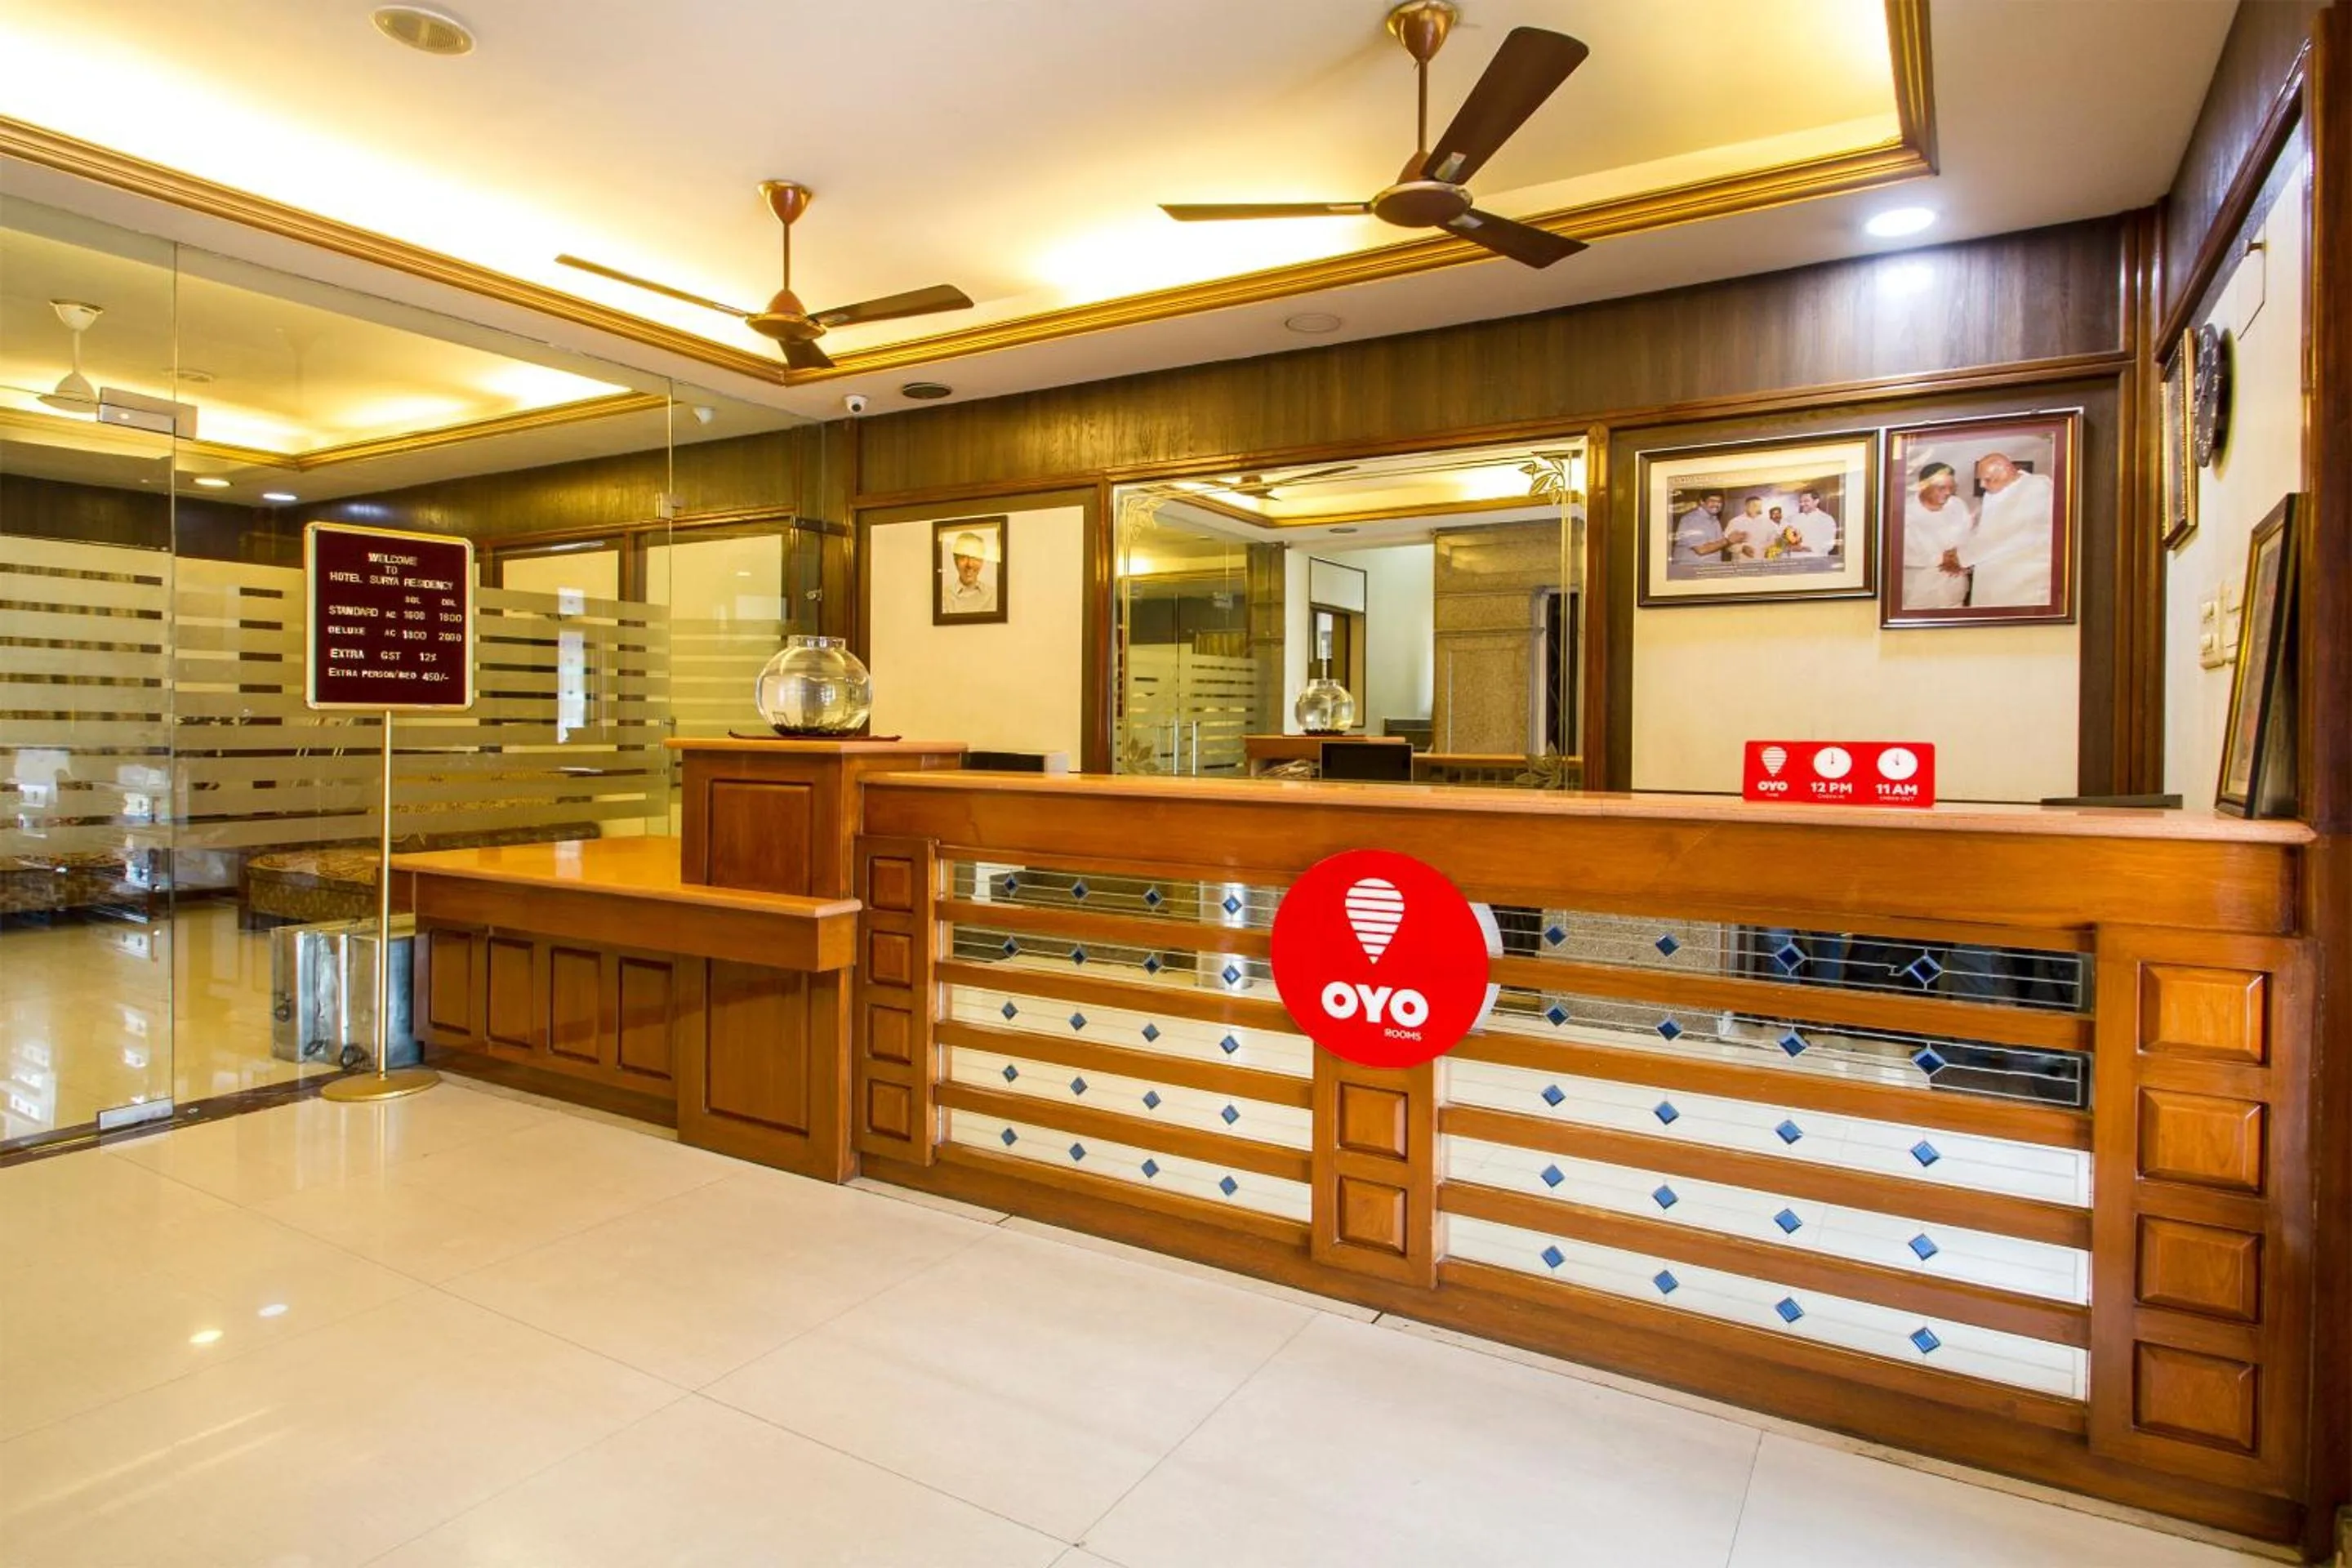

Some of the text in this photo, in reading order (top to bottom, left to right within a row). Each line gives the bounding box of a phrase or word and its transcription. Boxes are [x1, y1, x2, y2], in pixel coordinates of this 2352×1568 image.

[368, 552, 418, 567] WELCOME
[385, 565, 398, 574] TO
[330, 572, 453, 590] HOTEL SURYA RESIDENCY
[328, 605, 378, 617] STANDARD
[327, 625, 366, 635] DELUXE
[438, 632, 462, 642] 2000
[330, 648, 365, 659] EXTRA
[381, 650, 402, 661] GST
[1757, 781, 1788, 792] OYO
[1811, 782, 1853, 795] 12 PM
[1875, 783, 1918, 796] 11 AM
[1321, 981, 1429, 1027] OYO
[1383, 1027, 1422, 1041] ROOMS
